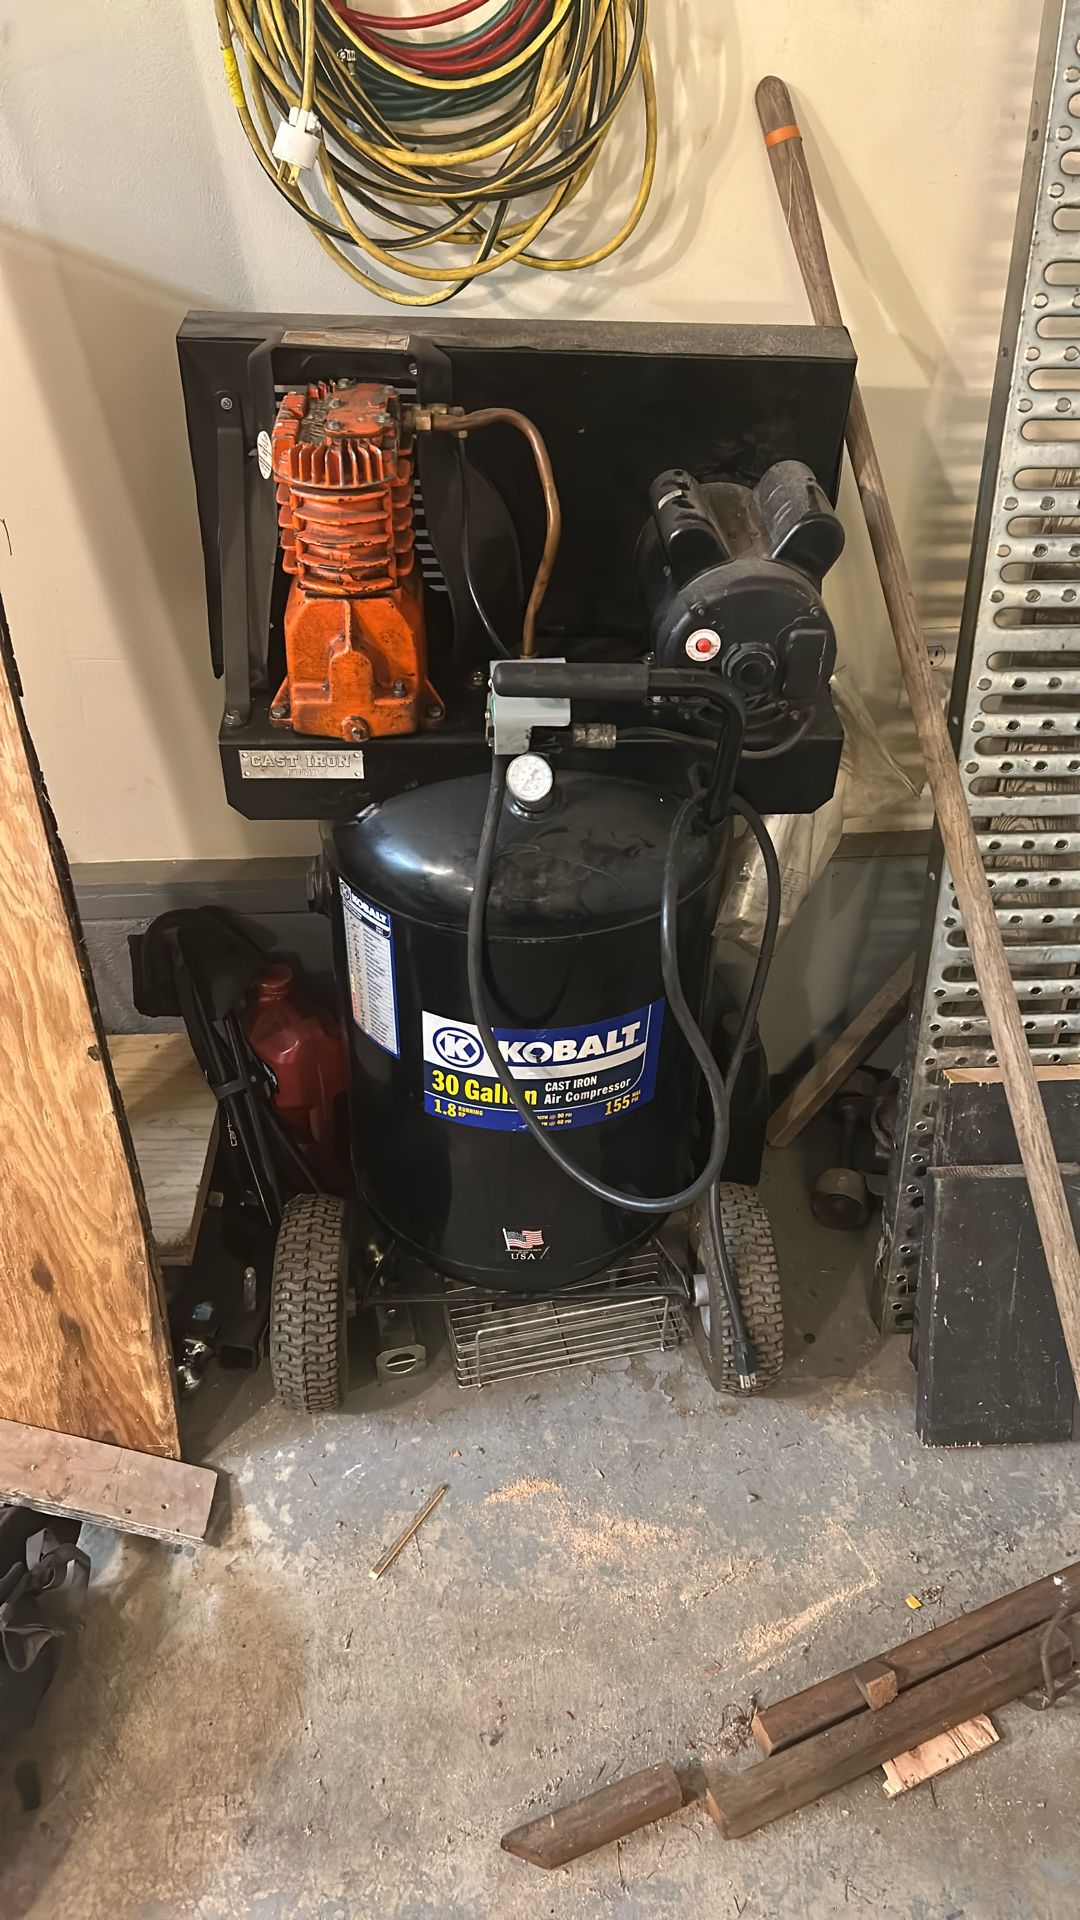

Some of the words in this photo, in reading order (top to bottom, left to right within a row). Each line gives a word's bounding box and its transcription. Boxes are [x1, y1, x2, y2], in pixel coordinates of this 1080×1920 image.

[251, 754, 298, 767] CAST
[306, 754, 351, 767] IRON
[498, 1021, 640, 1064] KOBALT
[431, 1069, 459, 1096] 30
[464, 1079, 538, 1105] Galln
[543, 1093, 562, 1105] Air
[565, 1078, 632, 1103] Compressor
[544, 1080, 571, 1092] CAST
[573, 1075, 598, 1089] IRON
[434, 1098, 457, 1118] 1.8
[604, 1094, 631, 1116] 155
